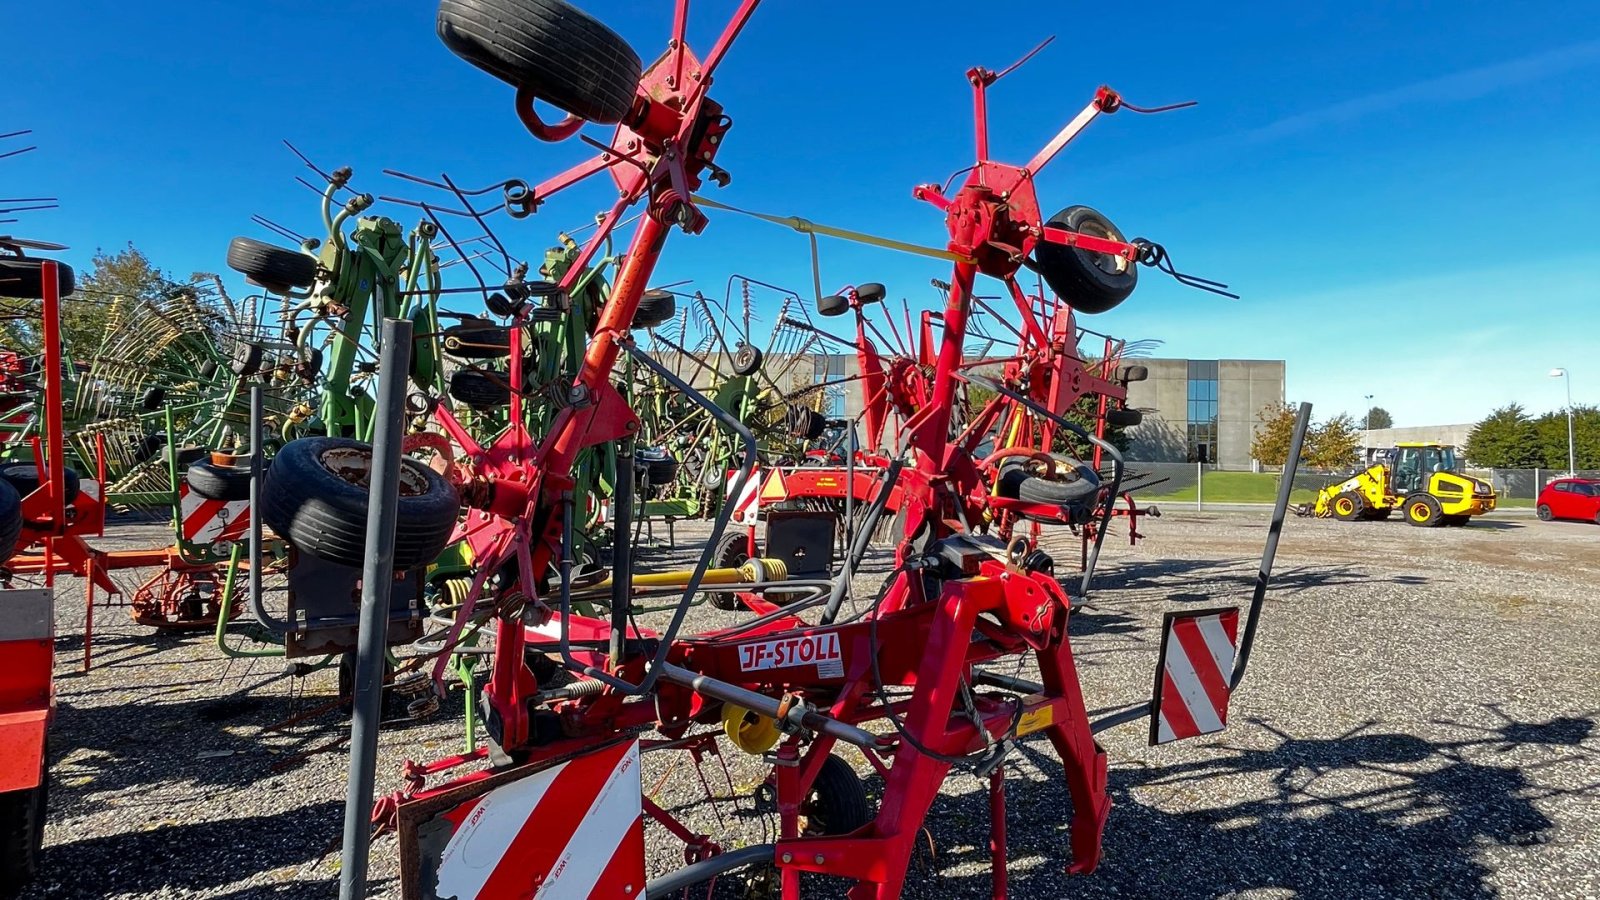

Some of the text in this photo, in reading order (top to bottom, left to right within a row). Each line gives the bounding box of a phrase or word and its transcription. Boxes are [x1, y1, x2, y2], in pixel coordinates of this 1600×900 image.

[742, 635, 839, 669] JF-STOLL
[470, 806, 486, 827] WGF
[554, 859, 568, 879] WGF
